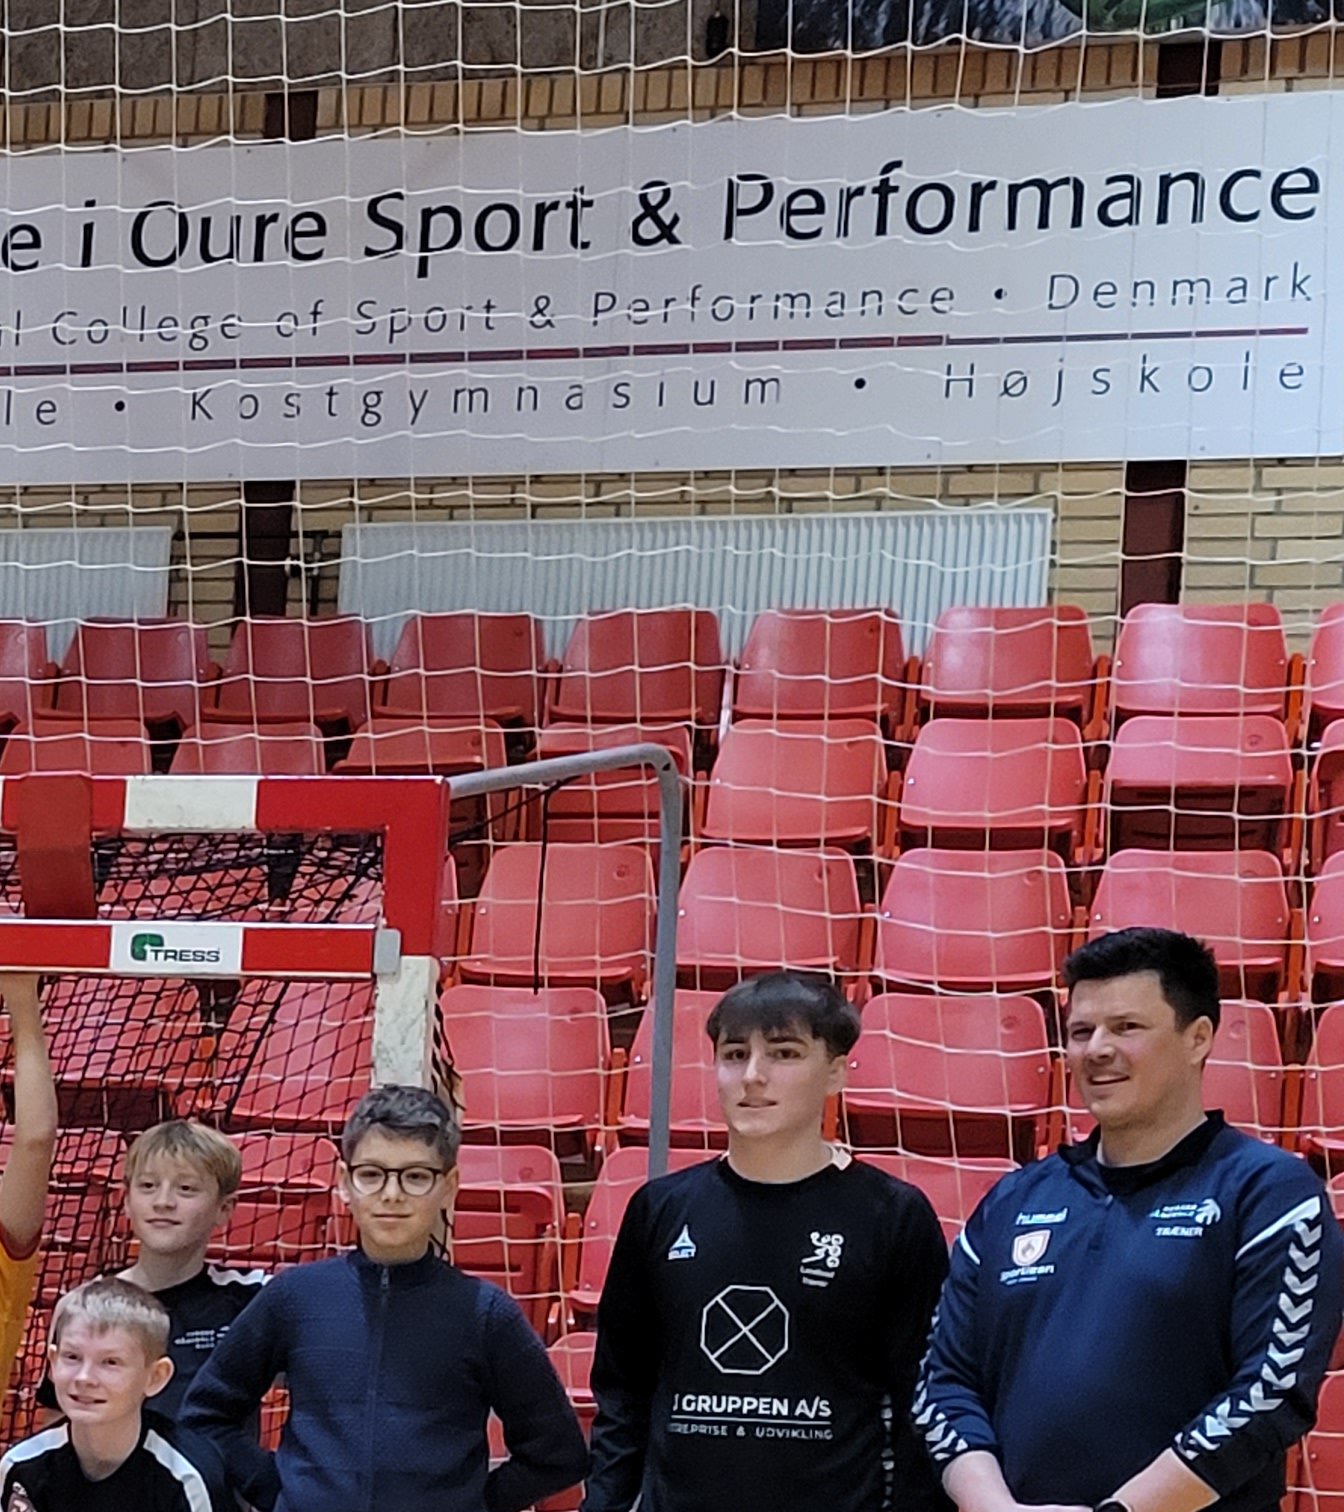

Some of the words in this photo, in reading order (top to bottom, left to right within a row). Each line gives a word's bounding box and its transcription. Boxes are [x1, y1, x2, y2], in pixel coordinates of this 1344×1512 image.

[80, 199, 96, 268] i
[130, 200, 327, 268] Oure
[363, 182, 593, 278] Sport
[630, 181, 682, 249] &
[723, 159, 1322, 242] Performance
[52, 304, 243, 352] College
[275, 299, 325, 339] of
[355, 298, 498, 344] Sport
[527, 293, 555, 328] &
[591, 281, 956, 326] Performance
[1047, 262, 1314, 312] Denmark
[190, 371, 782, 427] Kostgymnasium
[943, 353, 1305, 407] Højskole
[150, 949, 220, 962] TRESS
[682, 1394, 789, 1416] GRUPPEN
[794, 1395, 832, 1418] A/S
